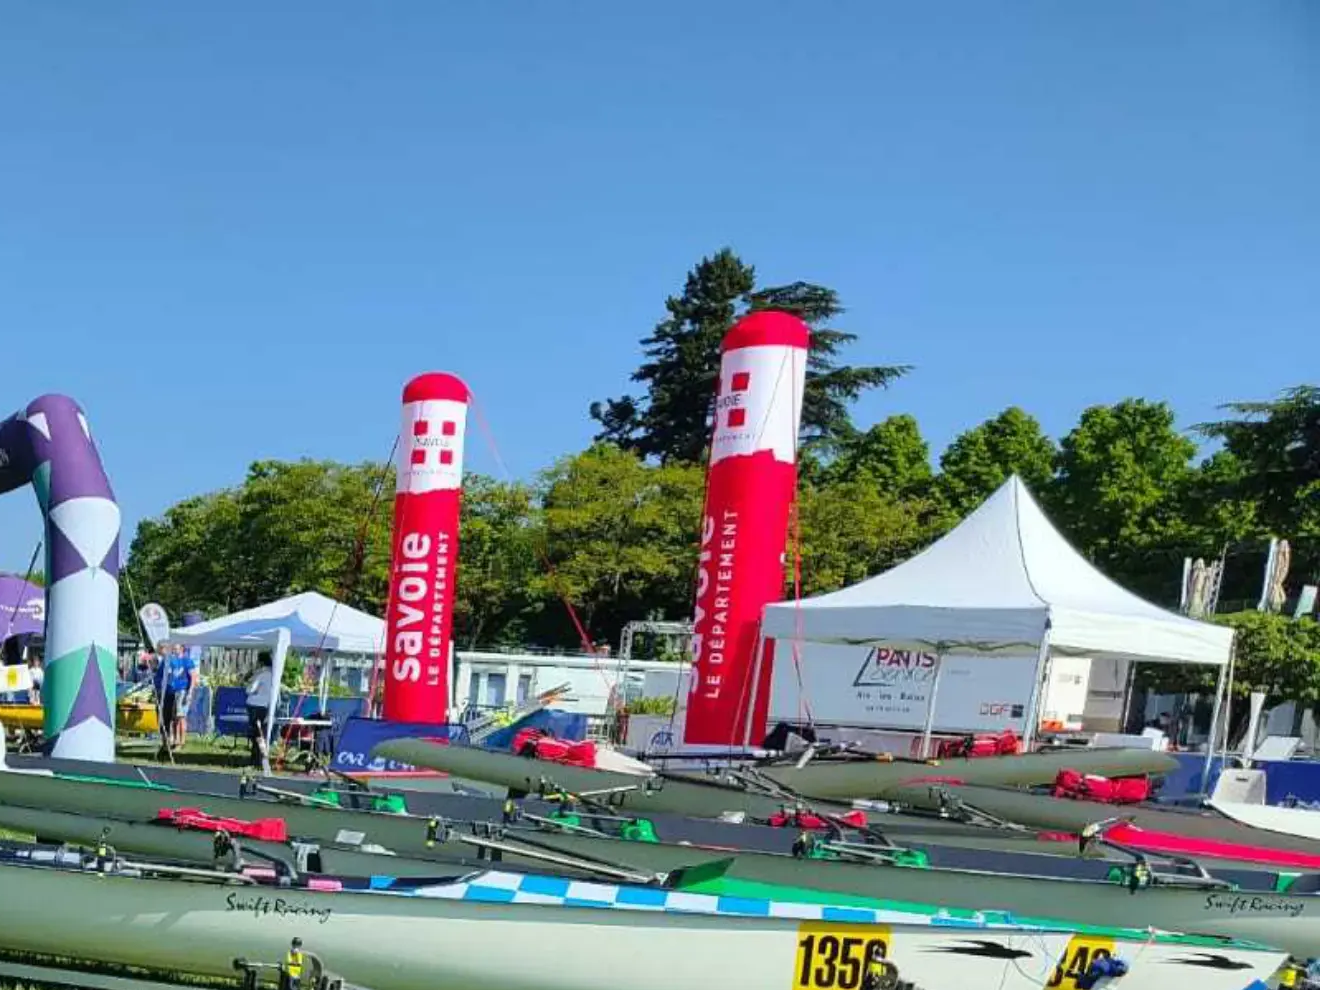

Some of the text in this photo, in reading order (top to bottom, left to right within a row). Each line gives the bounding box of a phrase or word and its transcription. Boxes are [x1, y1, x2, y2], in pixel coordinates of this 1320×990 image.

[393, 532, 431, 682] savoie
[427, 532, 449, 686] LE DÉPARTEMENT
[706, 510, 739, 699] LE DÉPARTEMENT
[226, 892, 332, 924] Swift Racing
[1204, 894, 1305, 917] Swift Racing
